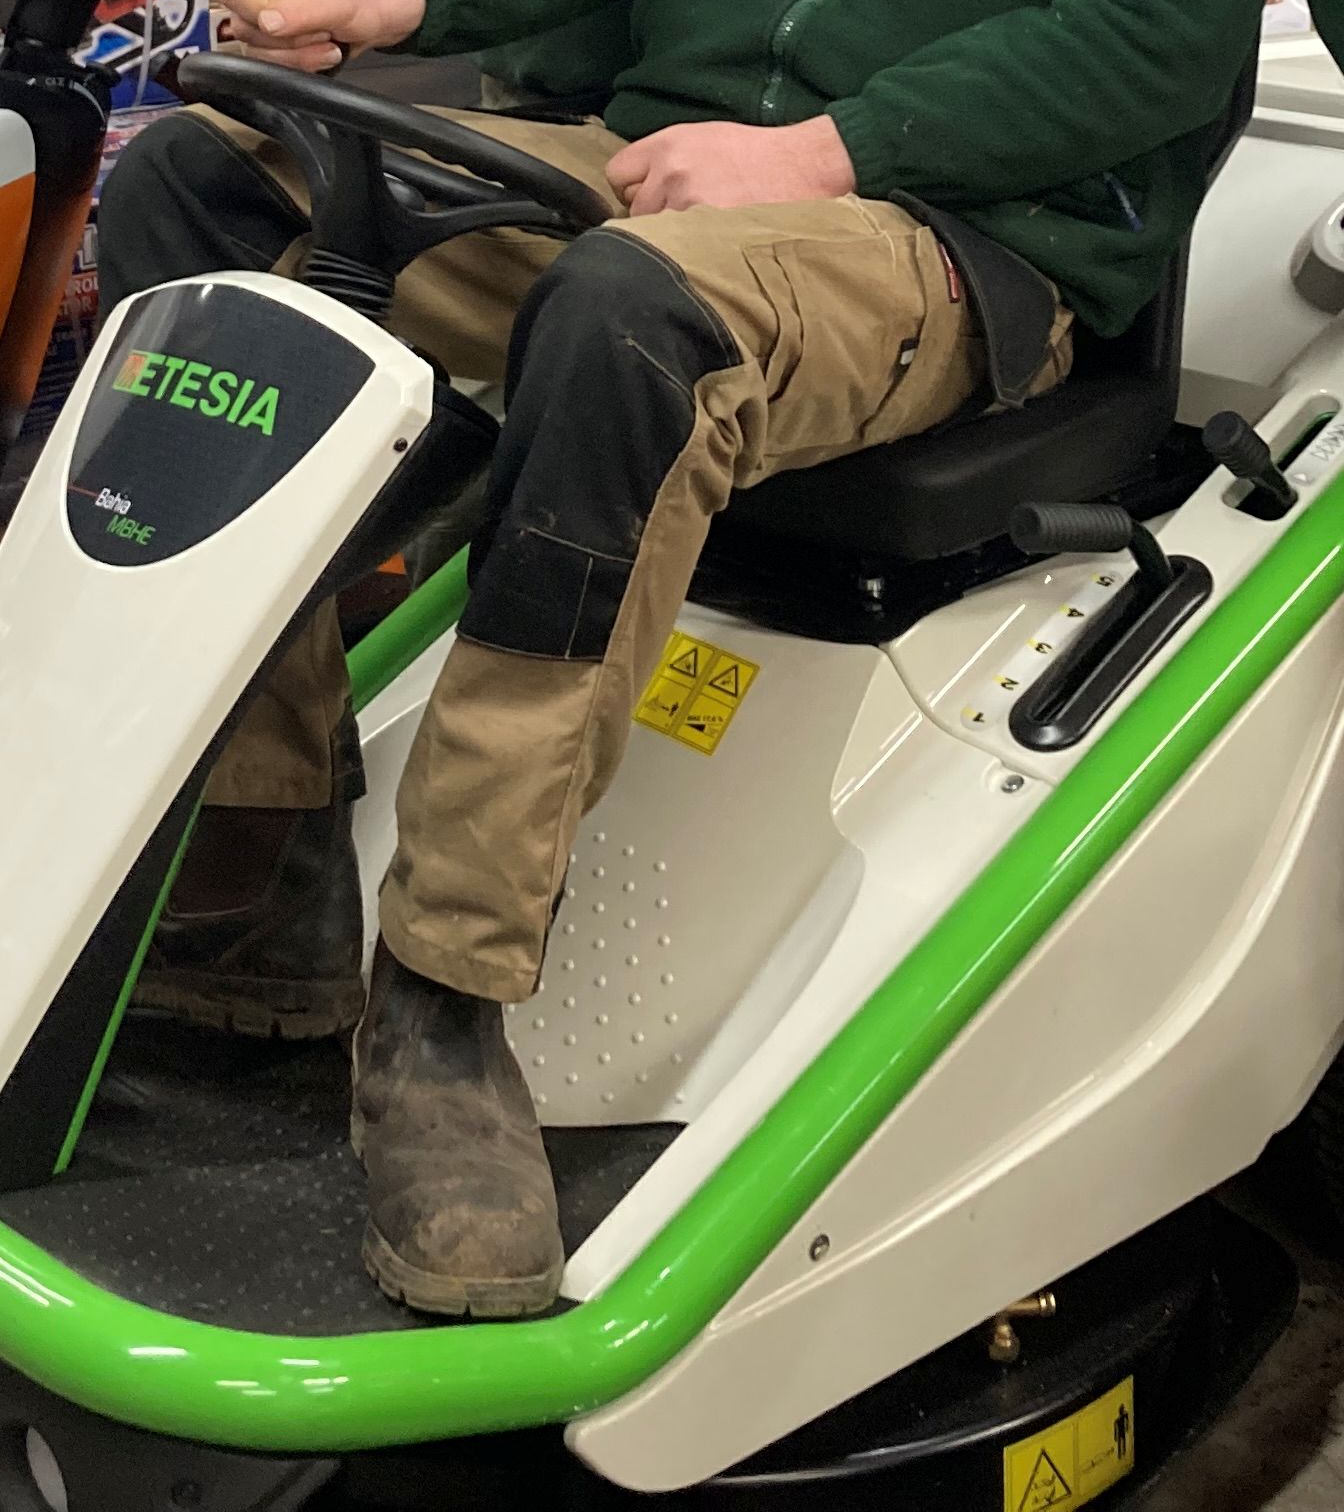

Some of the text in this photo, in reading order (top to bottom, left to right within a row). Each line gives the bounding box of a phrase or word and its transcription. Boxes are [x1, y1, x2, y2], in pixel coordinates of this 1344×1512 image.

[123, 351, 280, 436] ETESIA
[95, 487, 133, 515] Bahia
[1096, 575, 1115, 588] 5
[1067, 607, 1085, 619] 4
[1034, 642, 1053, 654] 3
[1000, 677, 1020, 691] 2
